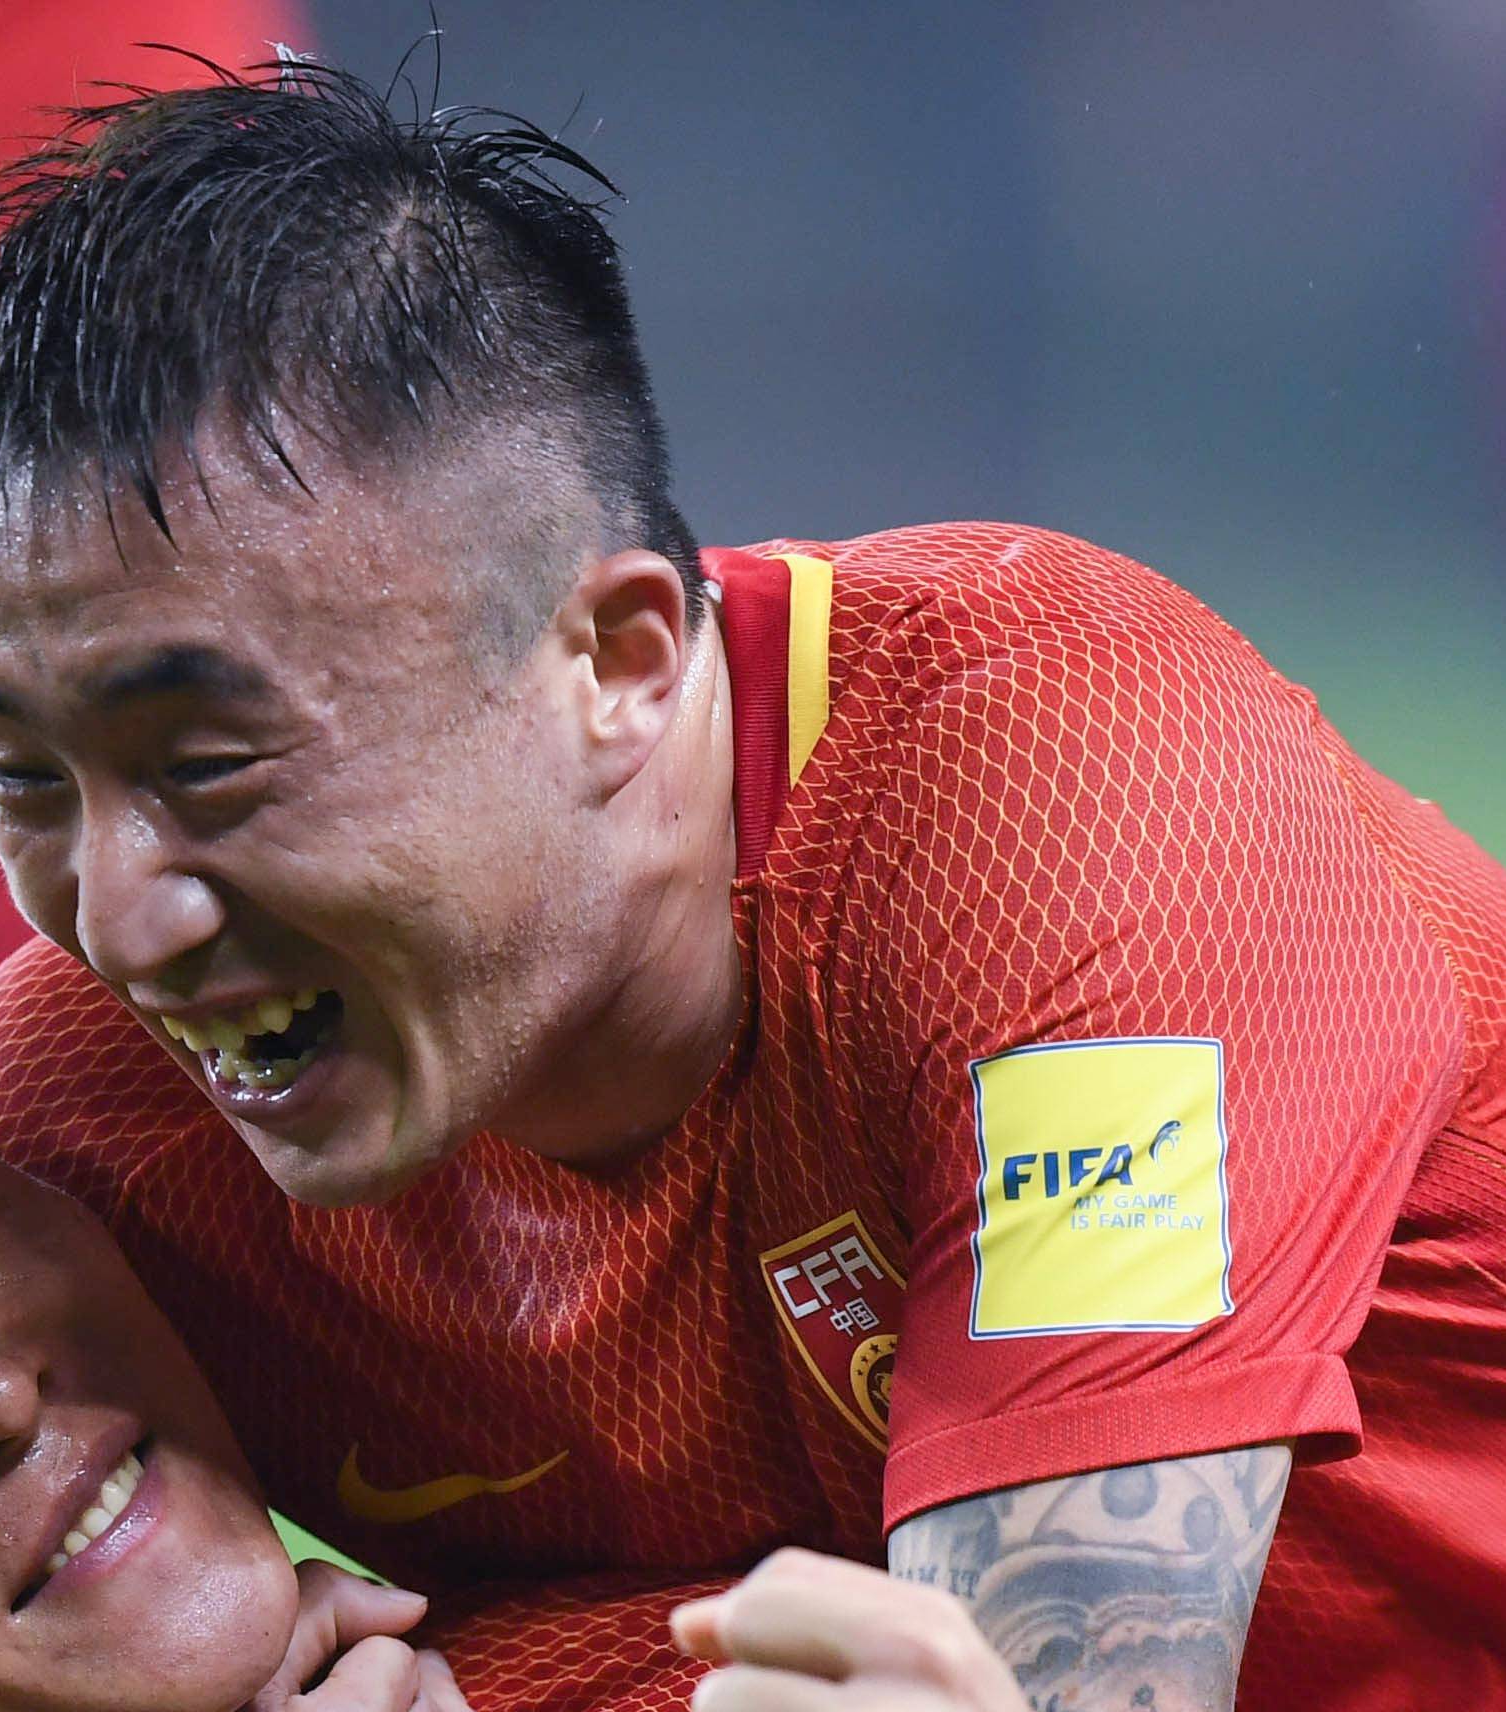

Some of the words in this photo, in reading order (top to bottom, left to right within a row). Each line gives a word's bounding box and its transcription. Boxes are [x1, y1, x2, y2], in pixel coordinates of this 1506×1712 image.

[1003, 1143, 1133, 1201] FIFA
[1075, 1195, 1105, 1210] MY
[1113, 1194, 1178, 1210] GAME
[1071, 1215, 1089, 1230] IS
[1099, 1213, 1146, 1229] FAIR
[1154, 1214, 1204, 1231] PLAY
[773, 1236, 884, 1319] CFA
